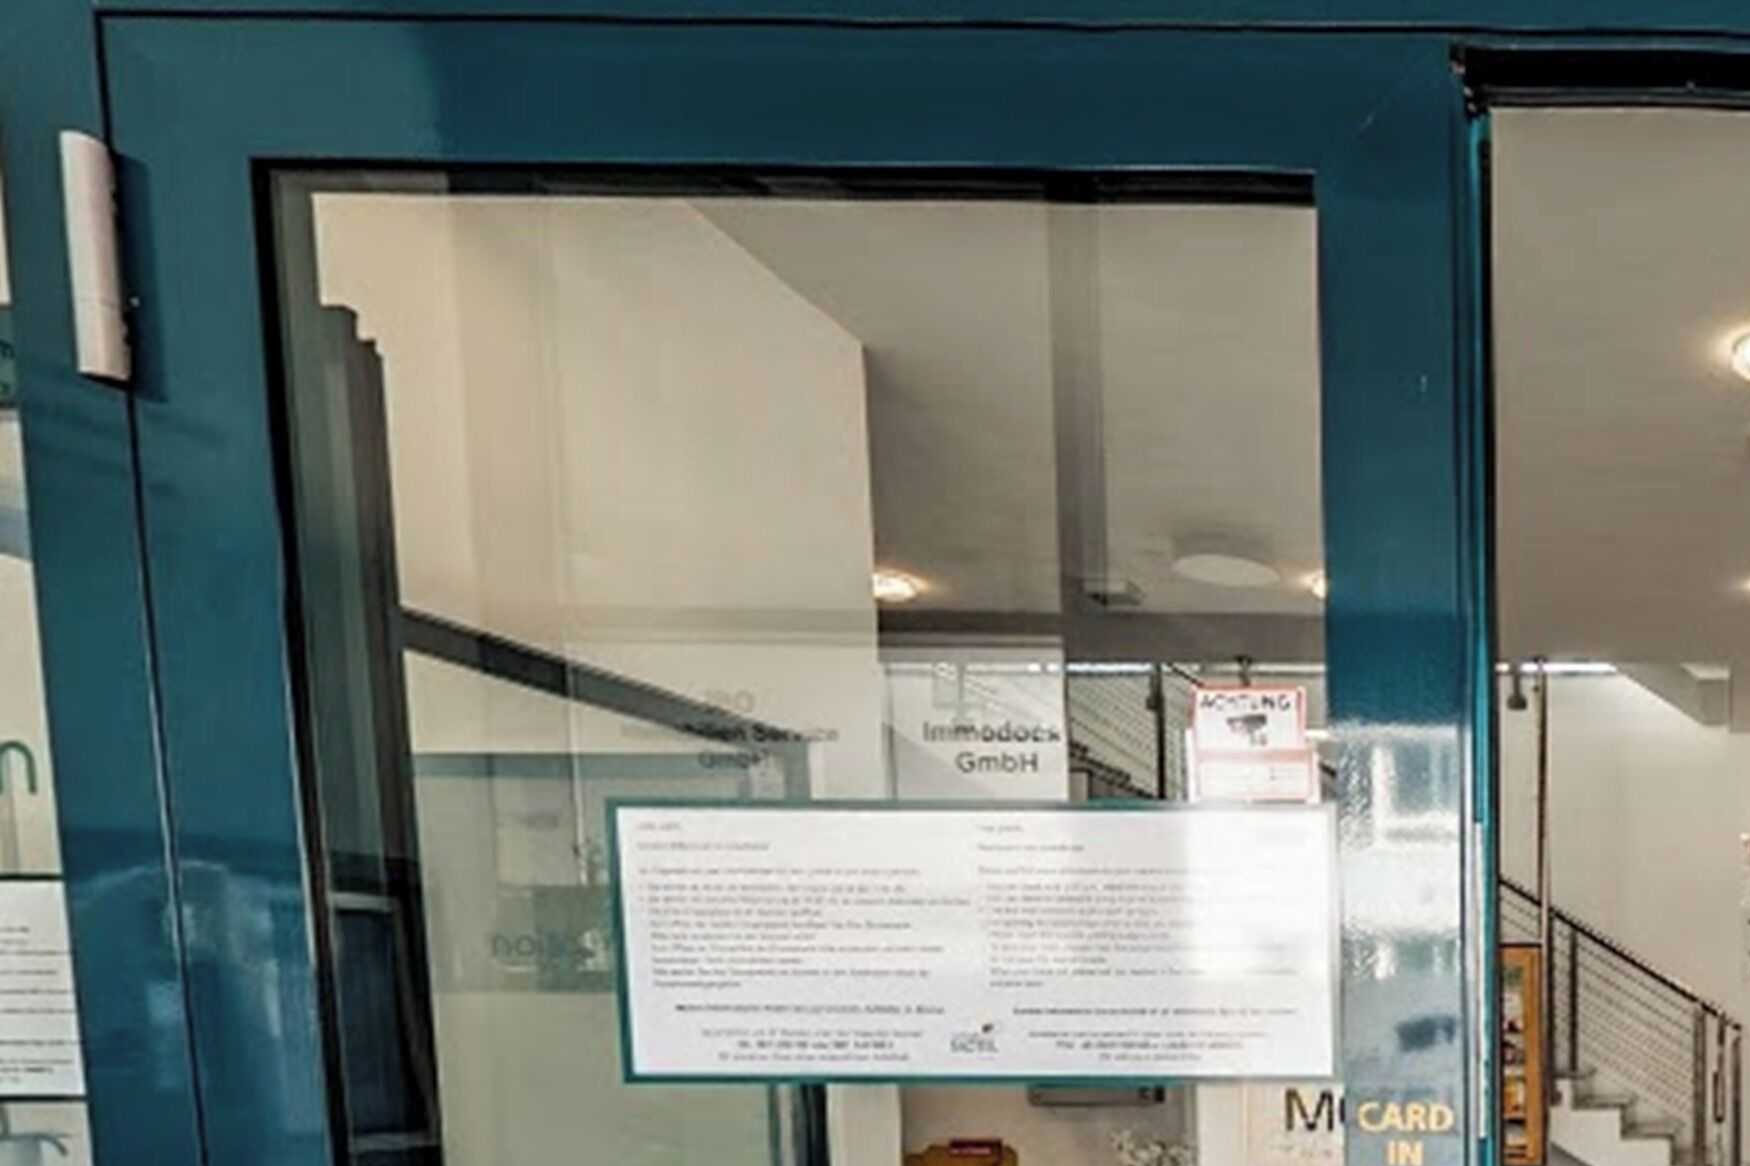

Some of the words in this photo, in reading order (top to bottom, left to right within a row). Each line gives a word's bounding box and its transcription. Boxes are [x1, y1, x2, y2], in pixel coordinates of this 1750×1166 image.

[955, 750, 1039, 774] GmbH
[1284, 1087, 1345, 1132] M
[1357, 1100, 1455, 1133] CARD
